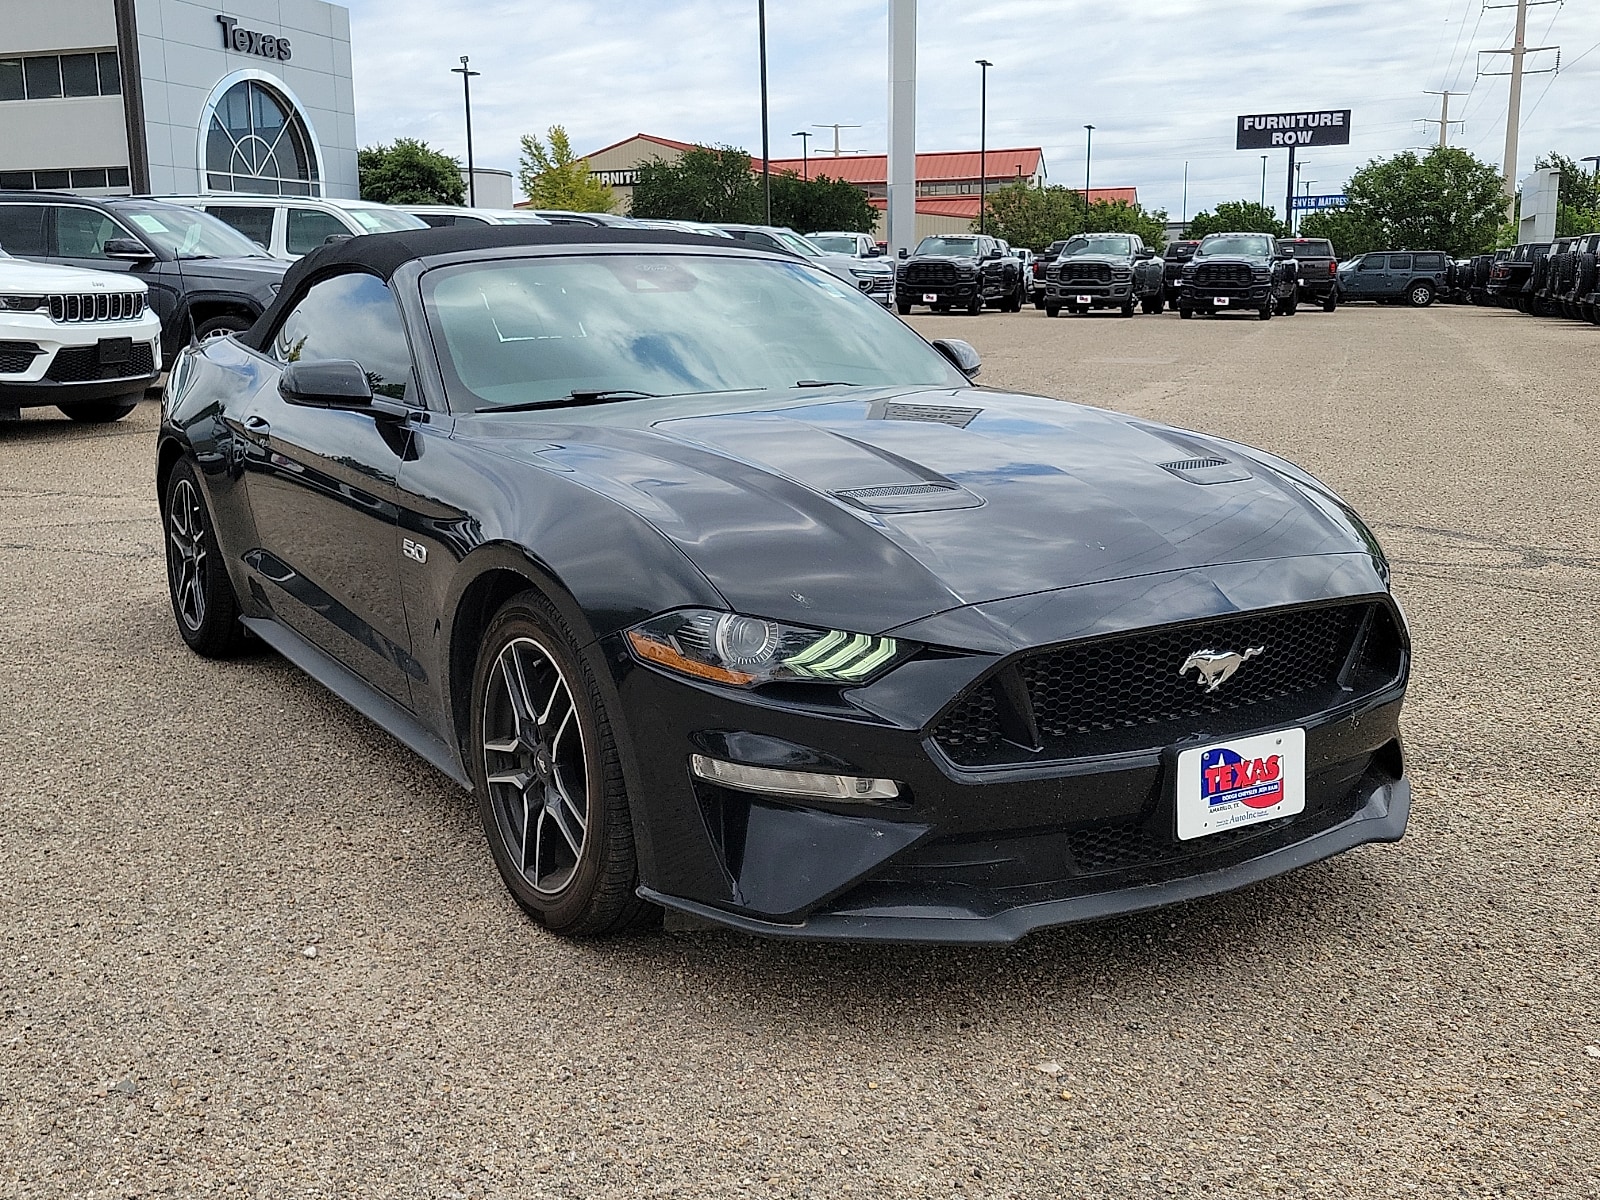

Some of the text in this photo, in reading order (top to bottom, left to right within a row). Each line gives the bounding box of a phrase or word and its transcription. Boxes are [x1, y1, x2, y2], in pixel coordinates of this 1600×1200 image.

[216, 14, 291, 61] Texas
[1243, 112, 1344, 130] FURNITURE
[1271, 130, 1313, 145] ROW
[584, 171, 642, 185] FURNITU
[1292, 197, 1349, 208] ENVER MATTRES
[1205, 755, 1280, 794] TEXAS
[1229, 811, 1257, 824] AutoInc
